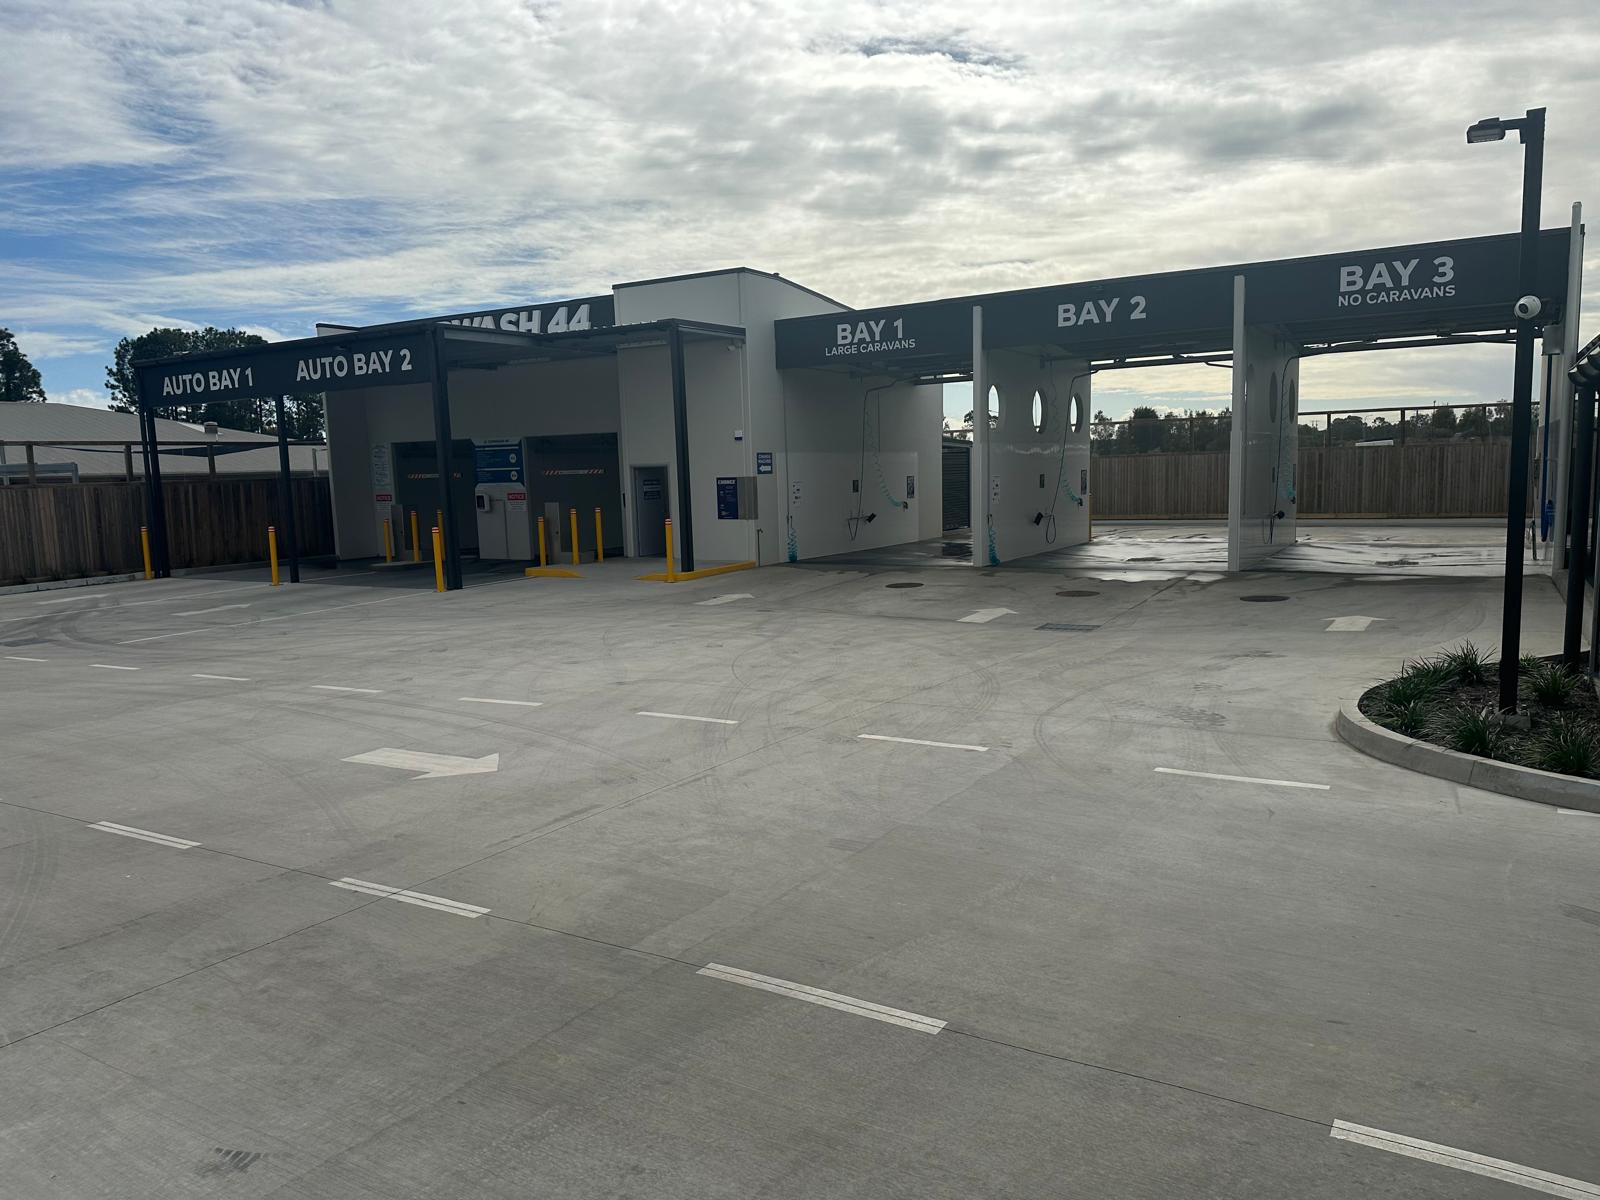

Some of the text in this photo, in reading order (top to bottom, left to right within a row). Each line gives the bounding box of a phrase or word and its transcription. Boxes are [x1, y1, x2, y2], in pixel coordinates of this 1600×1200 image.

[1340, 256, 1455, 292] BAY 3
[1338, 285, 1456, 307] NO CARAVANS
[547, 303, 591, 333] 44
[1057, 295, 1147, 327] BAY 2
[837, 318, 903, 345] BAY 1
[825, 339, 916, 356] LARGE CARAVANS
[296, 349, 413, 382] AUTO BAY 2
[162, 367, 254, 396] AUTO BAY 1
